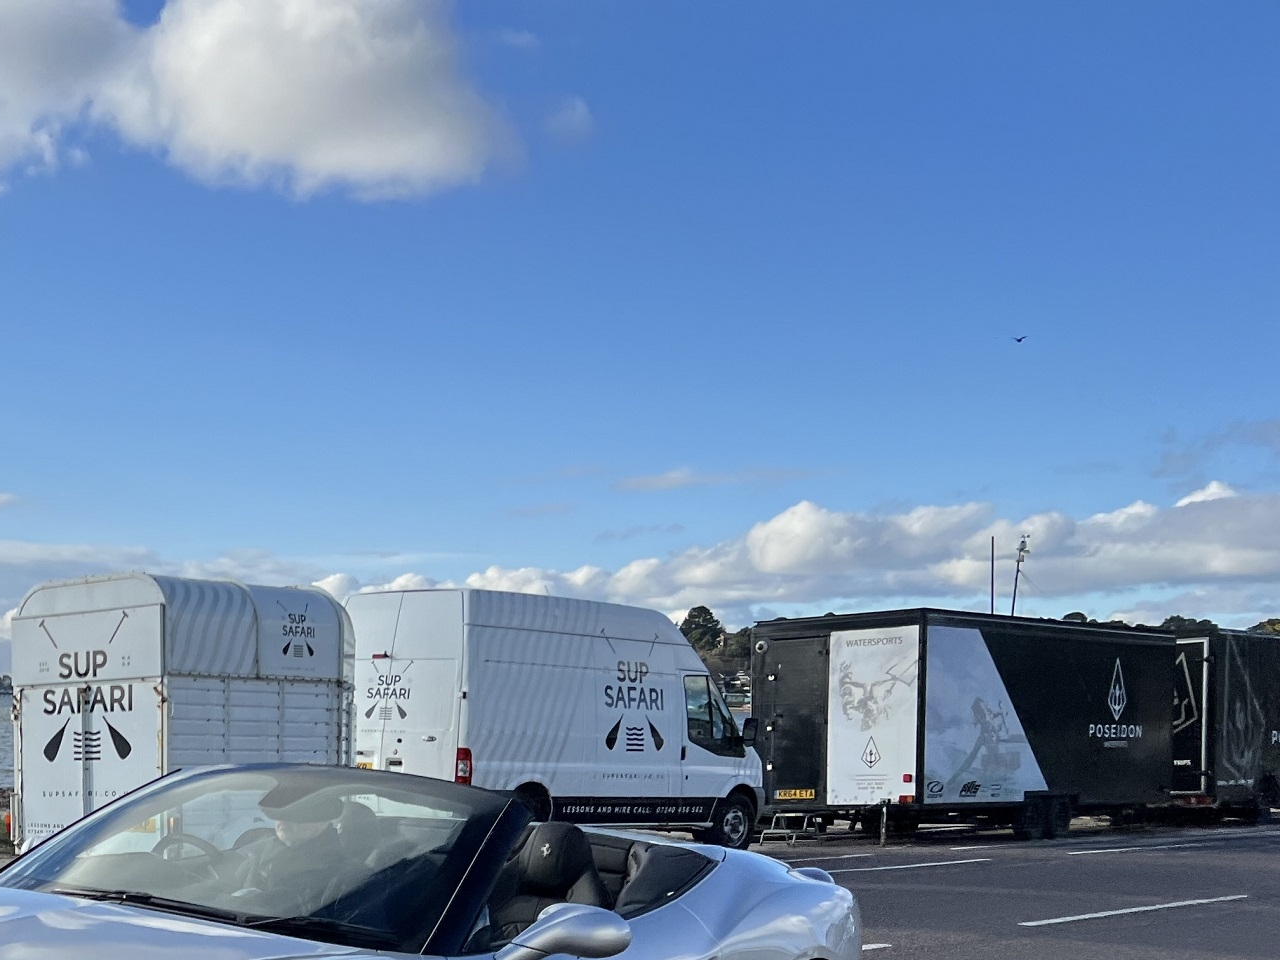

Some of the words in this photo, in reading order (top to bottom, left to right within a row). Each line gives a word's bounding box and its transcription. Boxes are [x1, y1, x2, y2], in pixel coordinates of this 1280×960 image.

[288, 613, 307, 625] SUP
[282, 625, 316, 638] SAFARI
[846, 636, 903, 647] WATERSPORTS
[58, 650, 108, 680] SUP
[617, 660, 649, 684] SUP
[377, 674, 402, 687] SUP
[43, 684, 133, 716] SAFARI
[366, 687, 411, 700] SAFARI
[604, 685, 664, 711] SAFARI
[1089, 724, 1143, 738] POSEIDON
[778, 790, 797, 798] KR64
[799, 789, 814, 798] ETA
[562, 805, 595, 813] LESSONS
[614, 806, 631, 814] HIRE
